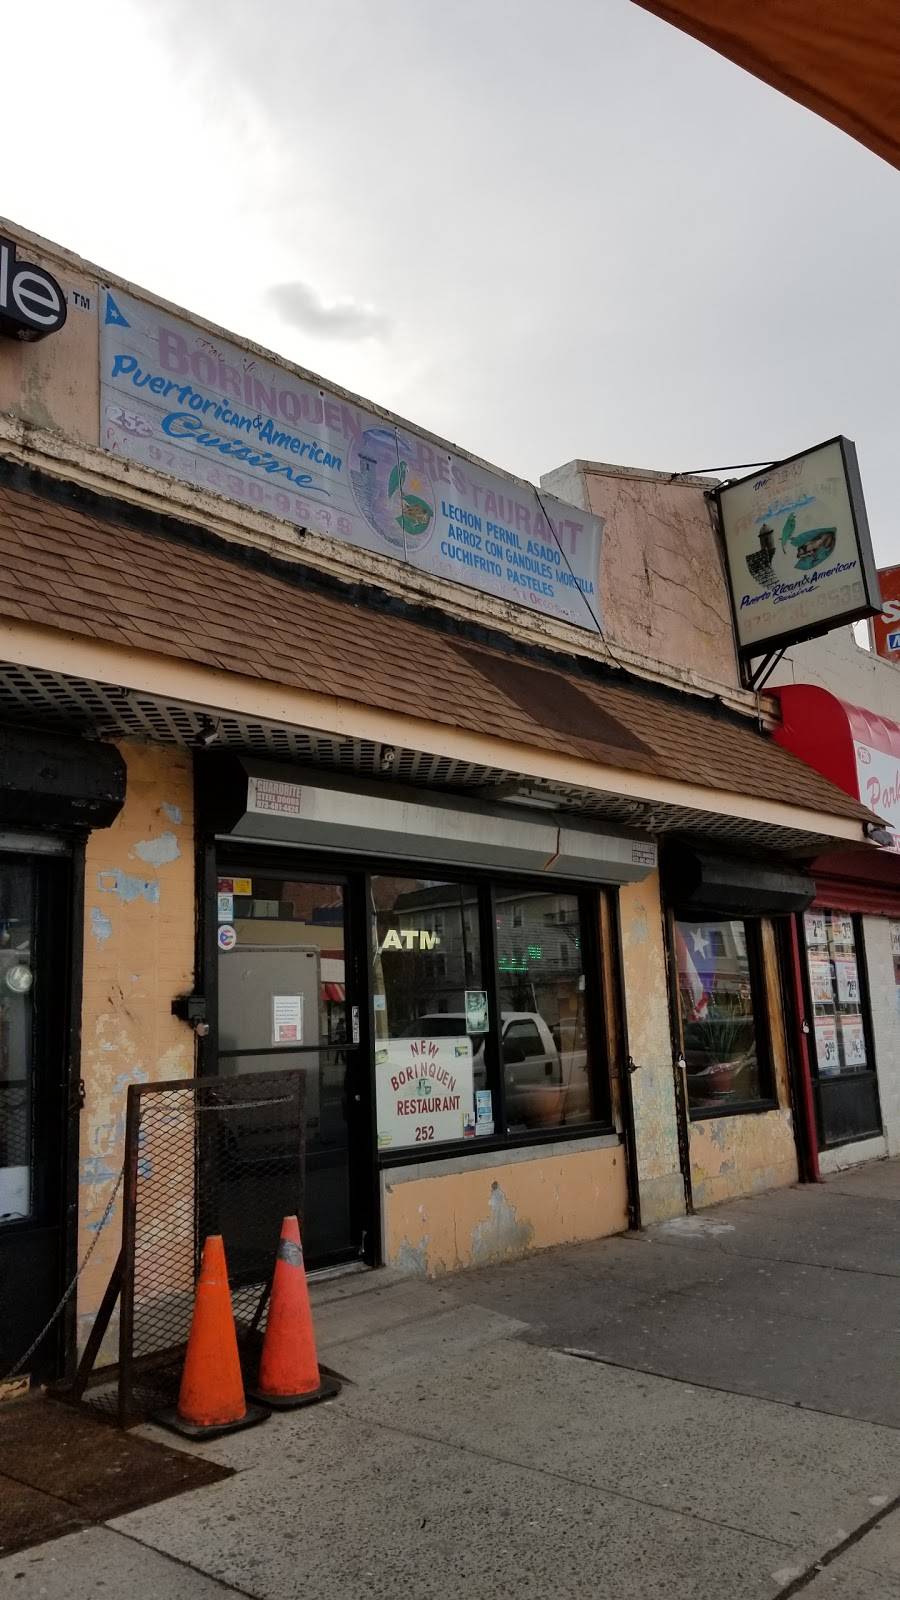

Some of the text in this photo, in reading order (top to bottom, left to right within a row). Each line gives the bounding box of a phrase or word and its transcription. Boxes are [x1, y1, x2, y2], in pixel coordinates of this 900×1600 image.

[72, 291, 91, 310] TM
[158, 325, 584, 555] BORINQUEN RESTAURANT
[161, 411, 331, 496] Cuisine
[259, 419, 343, 473] American
[441, 501, 561, 566] LECHON PERNIL ASADO
[448, 523, 482, 551] ARROZ
[485, 539, 503, 559] CON
[505, 549, 553, 580] GANDULES
[440, 541, 554, 598] CUCHIFRITO PASTELES
[771, 579, 802, 597] Rican
[809, 560, 857, 583] American
[381, 929, 441, 950] ATM
[410, 1040, 439, 1058] NEW
[390, 1062, 457, 1092] BORINQUEN
[396, 1095, 461, 1116] RESTAURANT
[415, 1126, 435, 1142] 252
